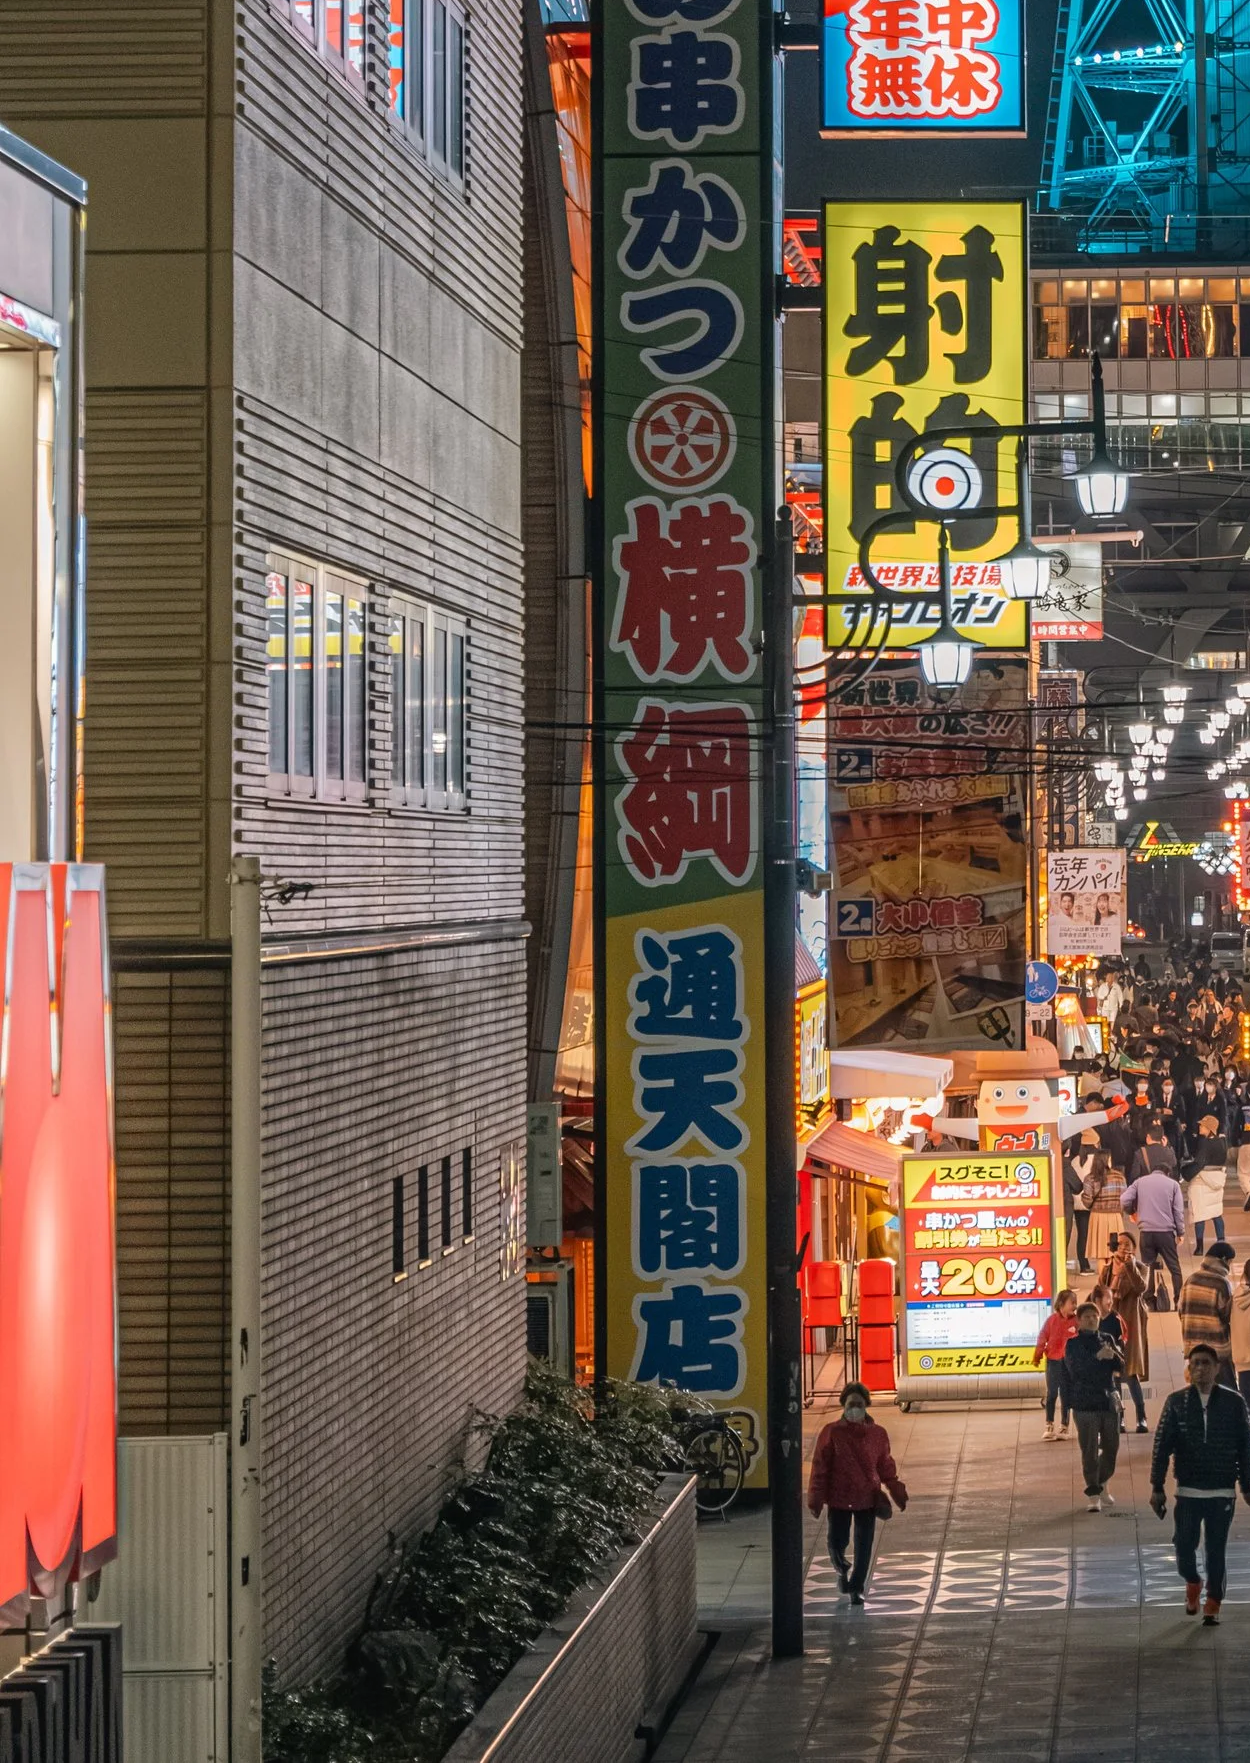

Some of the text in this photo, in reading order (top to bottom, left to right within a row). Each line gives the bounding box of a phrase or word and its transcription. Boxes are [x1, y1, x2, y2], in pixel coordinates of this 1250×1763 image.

[857, 52, 998, 110] 無休
[842, 224, 1004, 552] 射的
[613, 498, 756, 883] 横綱
[1049, 856, 1089, 875] 忘年
[630, 928, 748, 1395] 通天閣店
[939, 1164, 1009, 1181] スグそこ!
[925, 1210, 1029, 1230] 串かつ屋さんの
[920, 1261, 941, 1297] 最大
[941, 1257, 1006, 1295] 20
[1005, 1280, 1037, 1295] OFF
[955, 1353, 1020, 1368] チャンピオン
